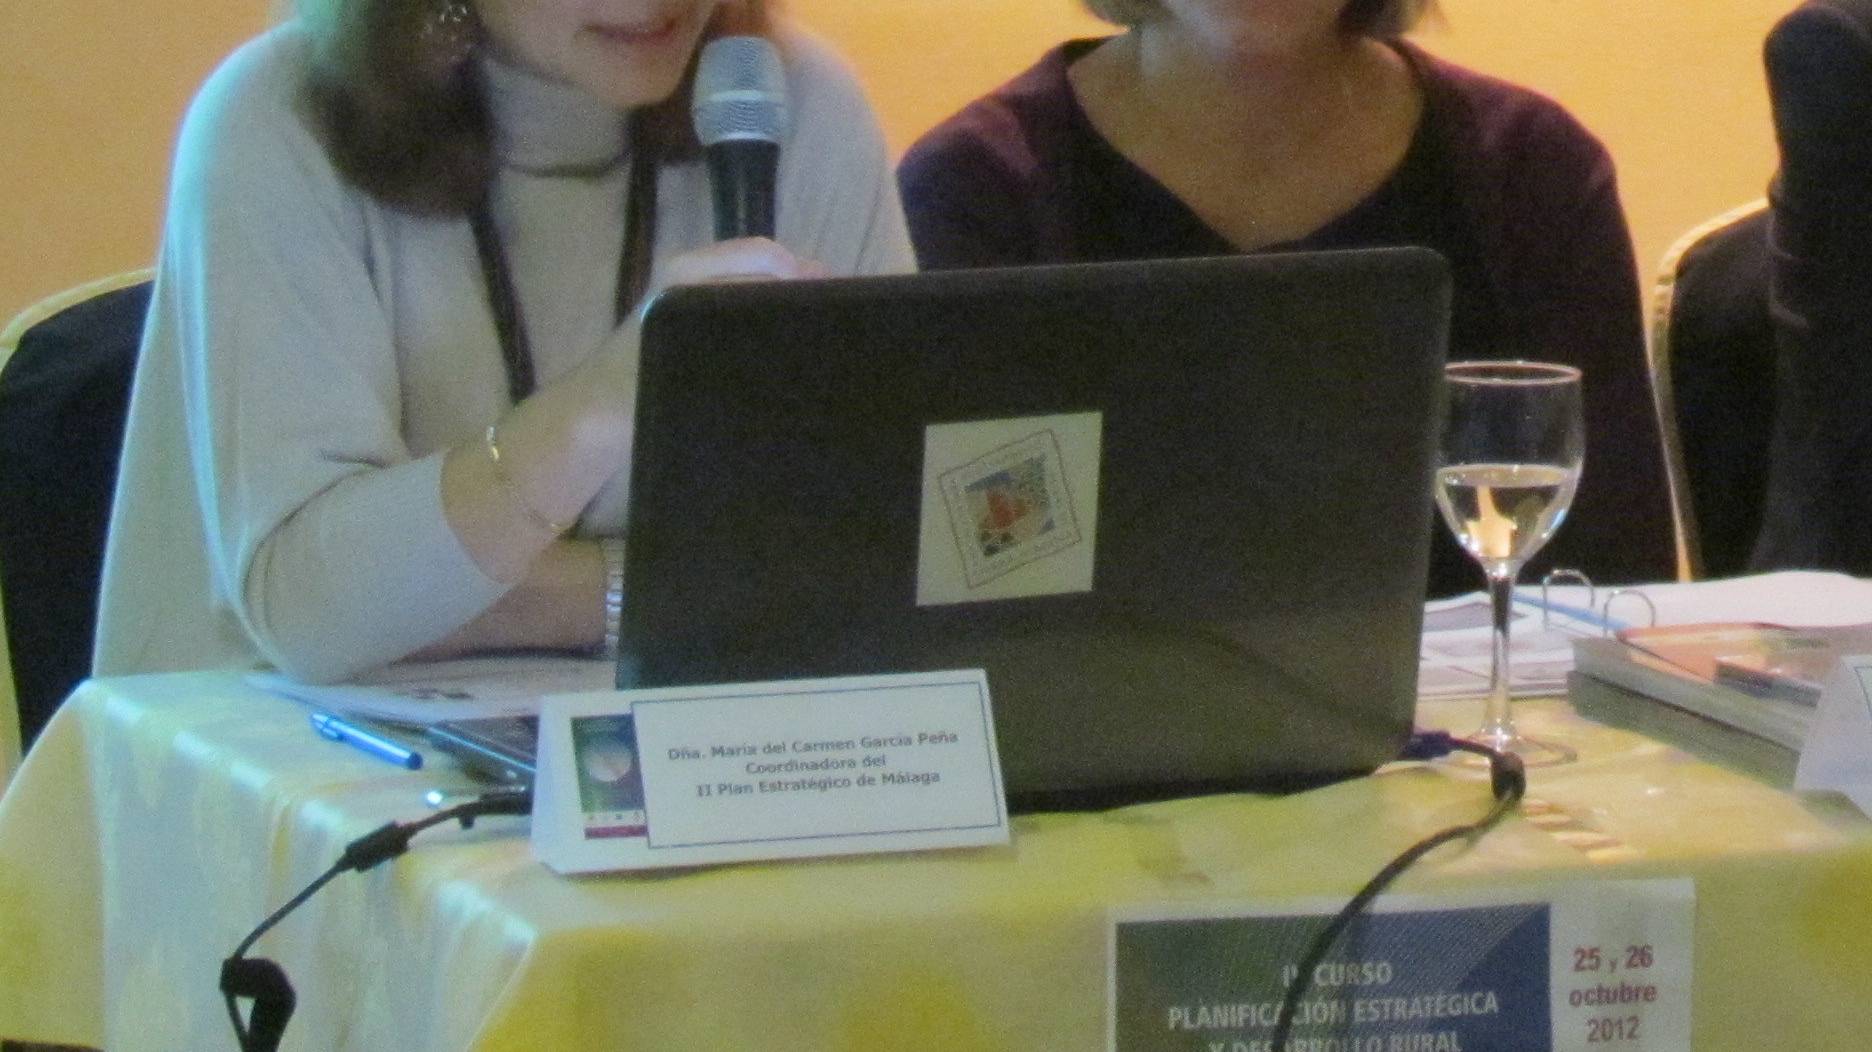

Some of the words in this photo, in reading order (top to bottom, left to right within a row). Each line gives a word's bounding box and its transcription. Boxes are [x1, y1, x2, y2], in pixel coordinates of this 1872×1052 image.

[711, 743, 757, 757] María
[762, 741, 786, 754] del
[791, 739, 855, 753] Carmen
[860, 733, 912, 749] García
[917, 730, 958, 745] Peña
[745, 757, 856, 774] Coordinadora
[862, 753, 886, 767] del
[697, 784, 712, 796] II
[717, 782, 754, 796] Plan
[758, 776, 851, 793] Estratégico
[856, 773, 877, 787] de
[881, 770, 940, 786] Málaga
[1573, 946, 1602, 972] 25
[1625, 944, 1654, 969] 26
[1314, 961, 1393, 986] CURSO
[1353, 990, 1499, 1023] ESTRATÉGICA
[1568, 983, 1658, 1007] octubre
[1586, 1015, 1642, 1043] 2012
